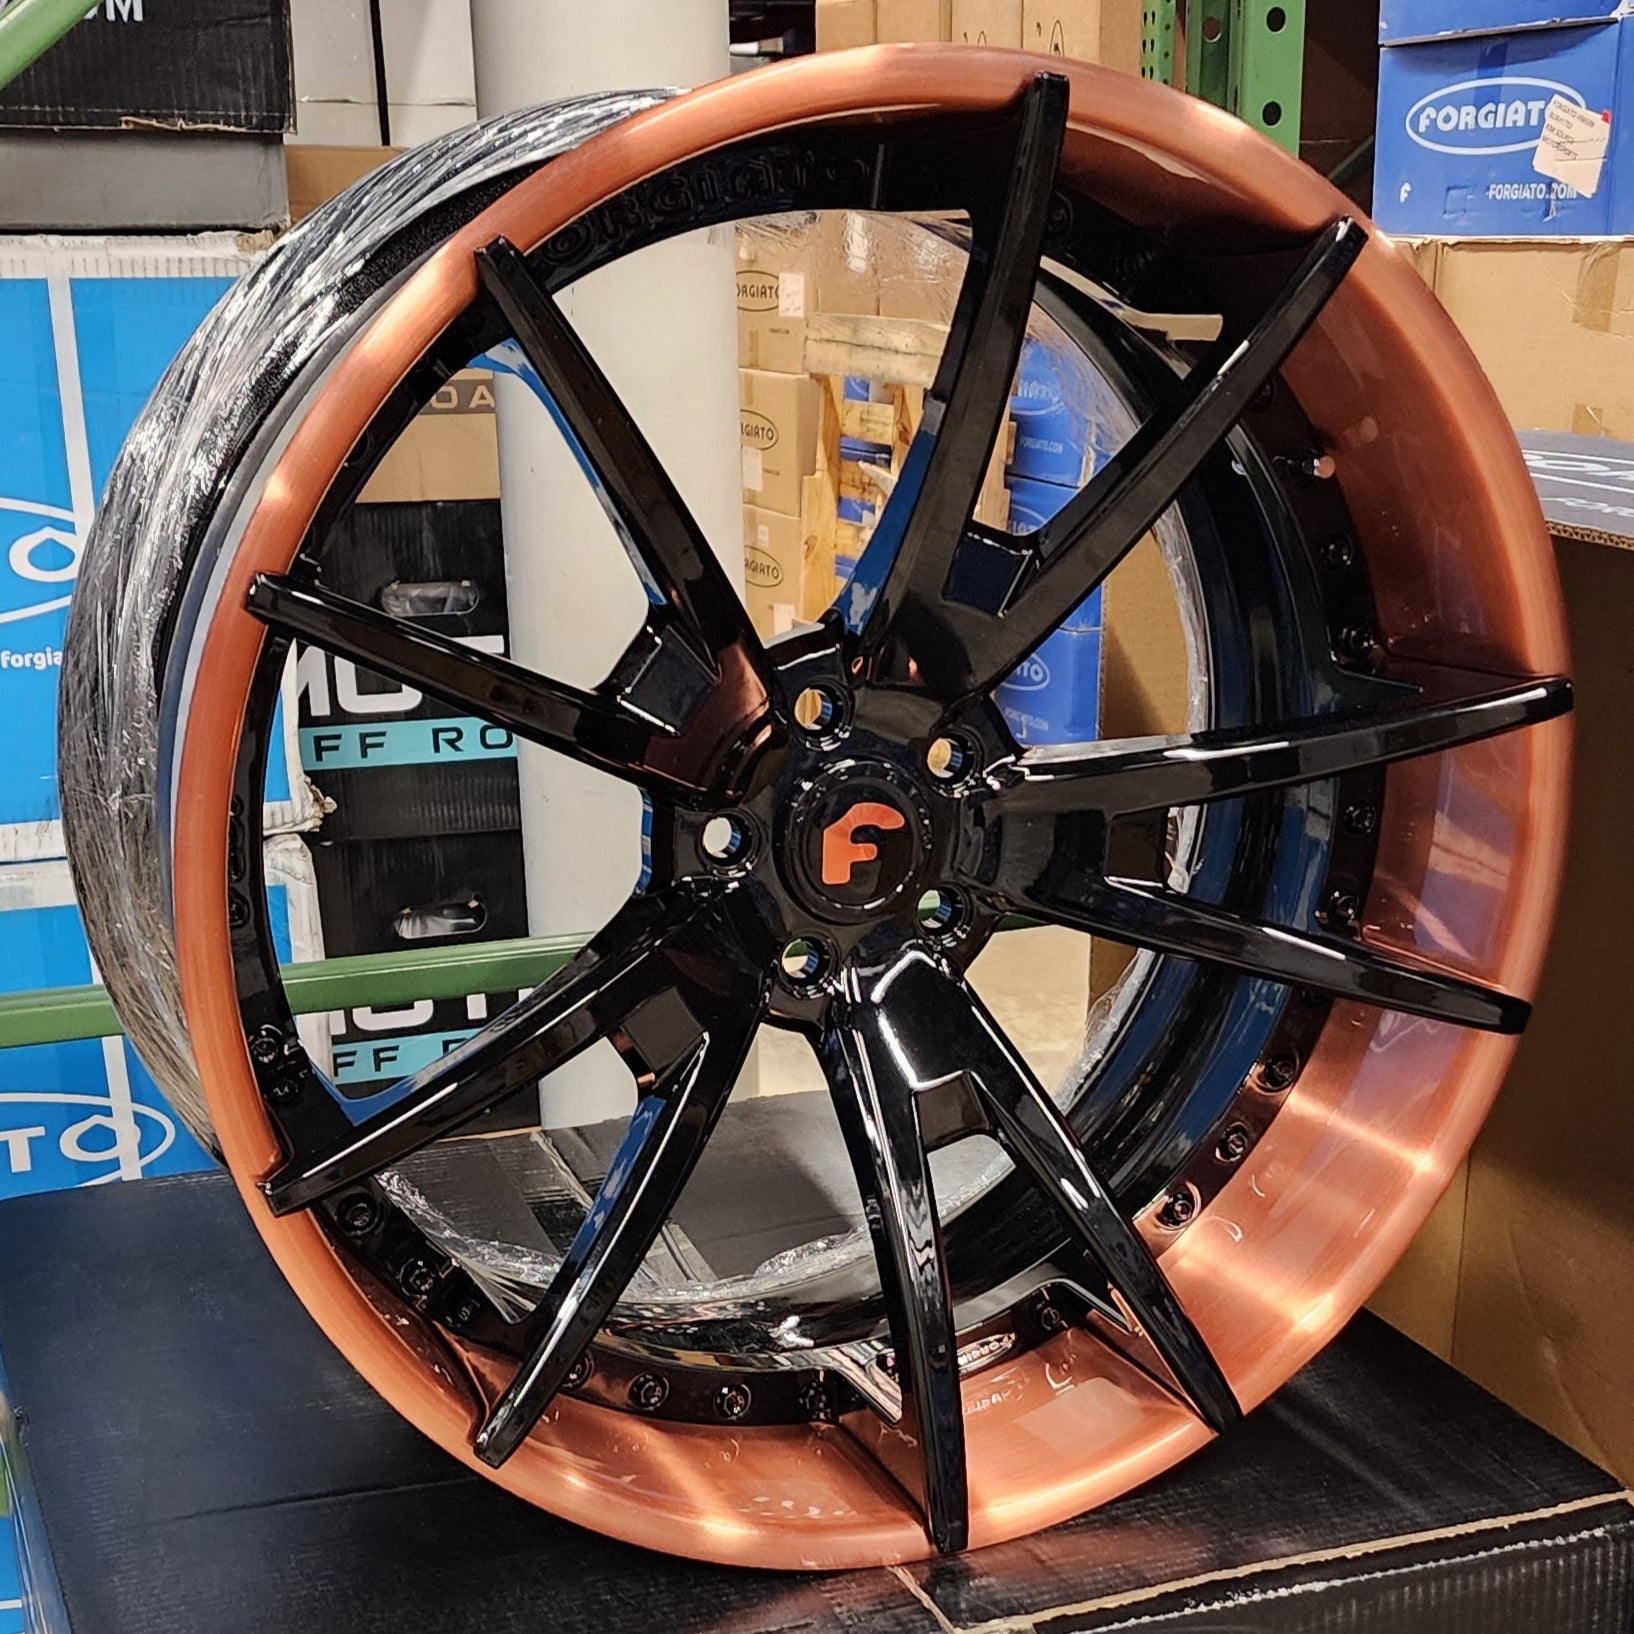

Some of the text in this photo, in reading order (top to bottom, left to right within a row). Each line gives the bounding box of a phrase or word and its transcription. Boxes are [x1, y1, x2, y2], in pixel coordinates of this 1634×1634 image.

[1418, 99, 1545, 133] FORGIAT
[740, 422, 774, 442] GIATO
[822, 801, 906, 886] F
